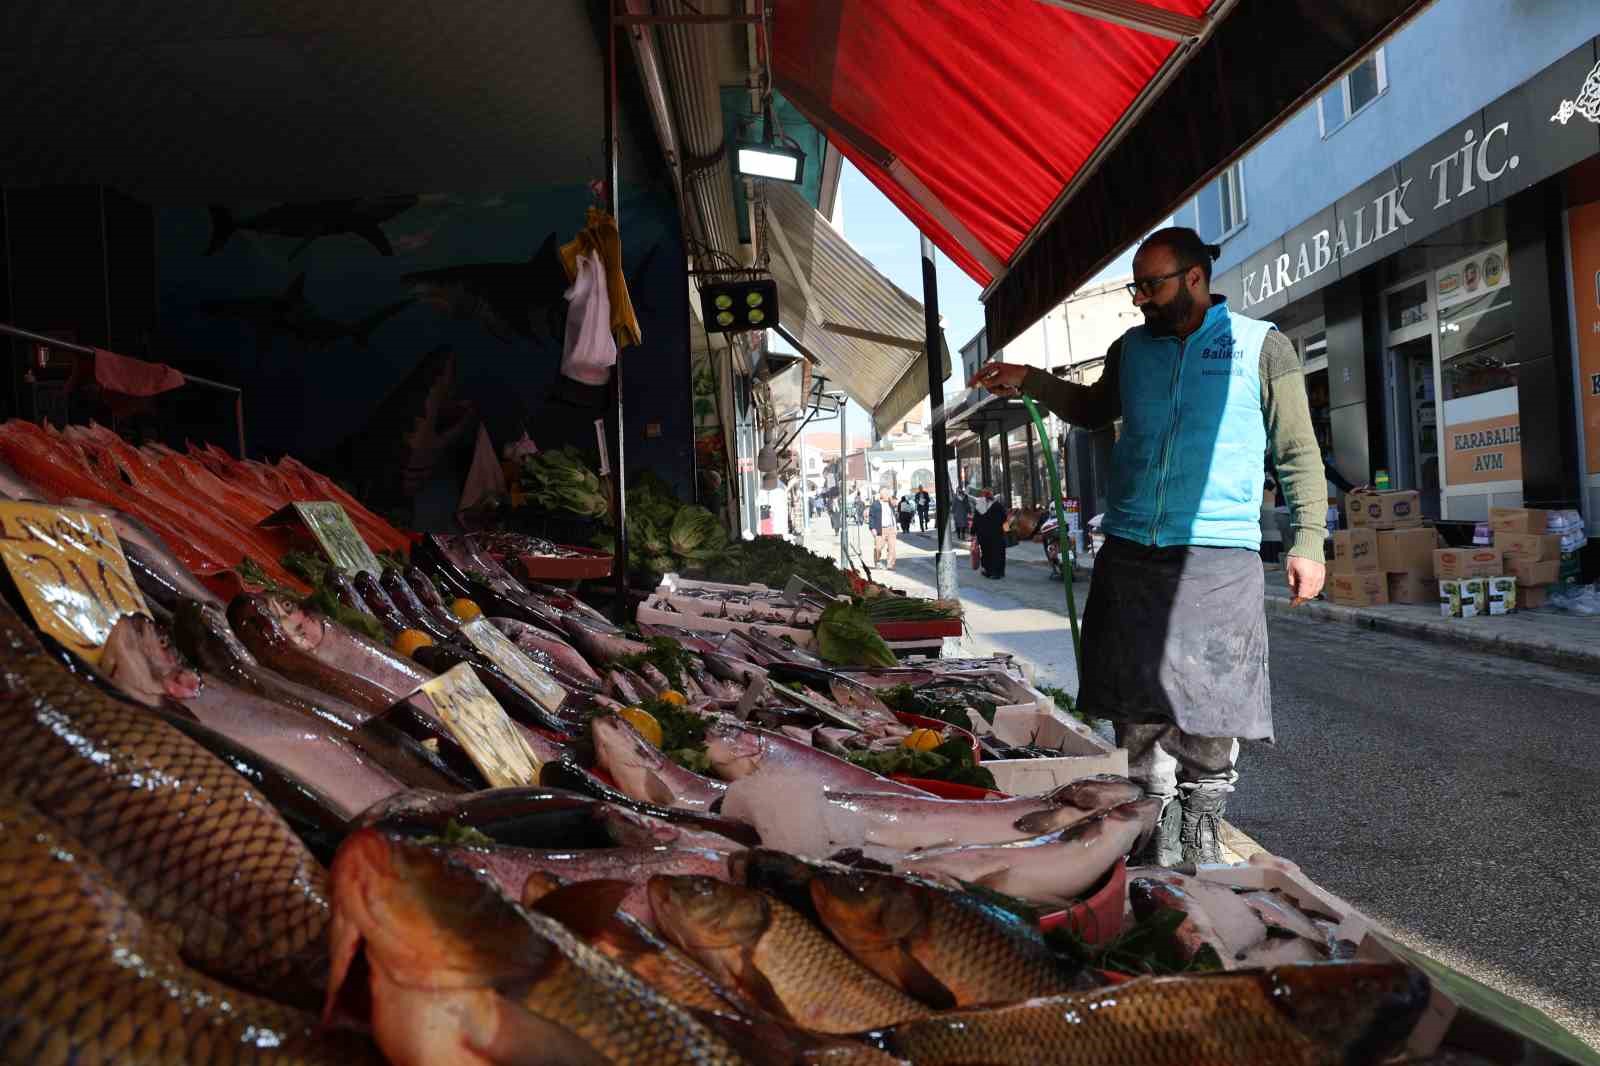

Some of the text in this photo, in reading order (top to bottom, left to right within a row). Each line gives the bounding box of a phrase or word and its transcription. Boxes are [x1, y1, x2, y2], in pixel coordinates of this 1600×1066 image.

[1240, 121, 1520, 311] KARABALIK TİC.
[1473, 453, 1504, 472] AVM
